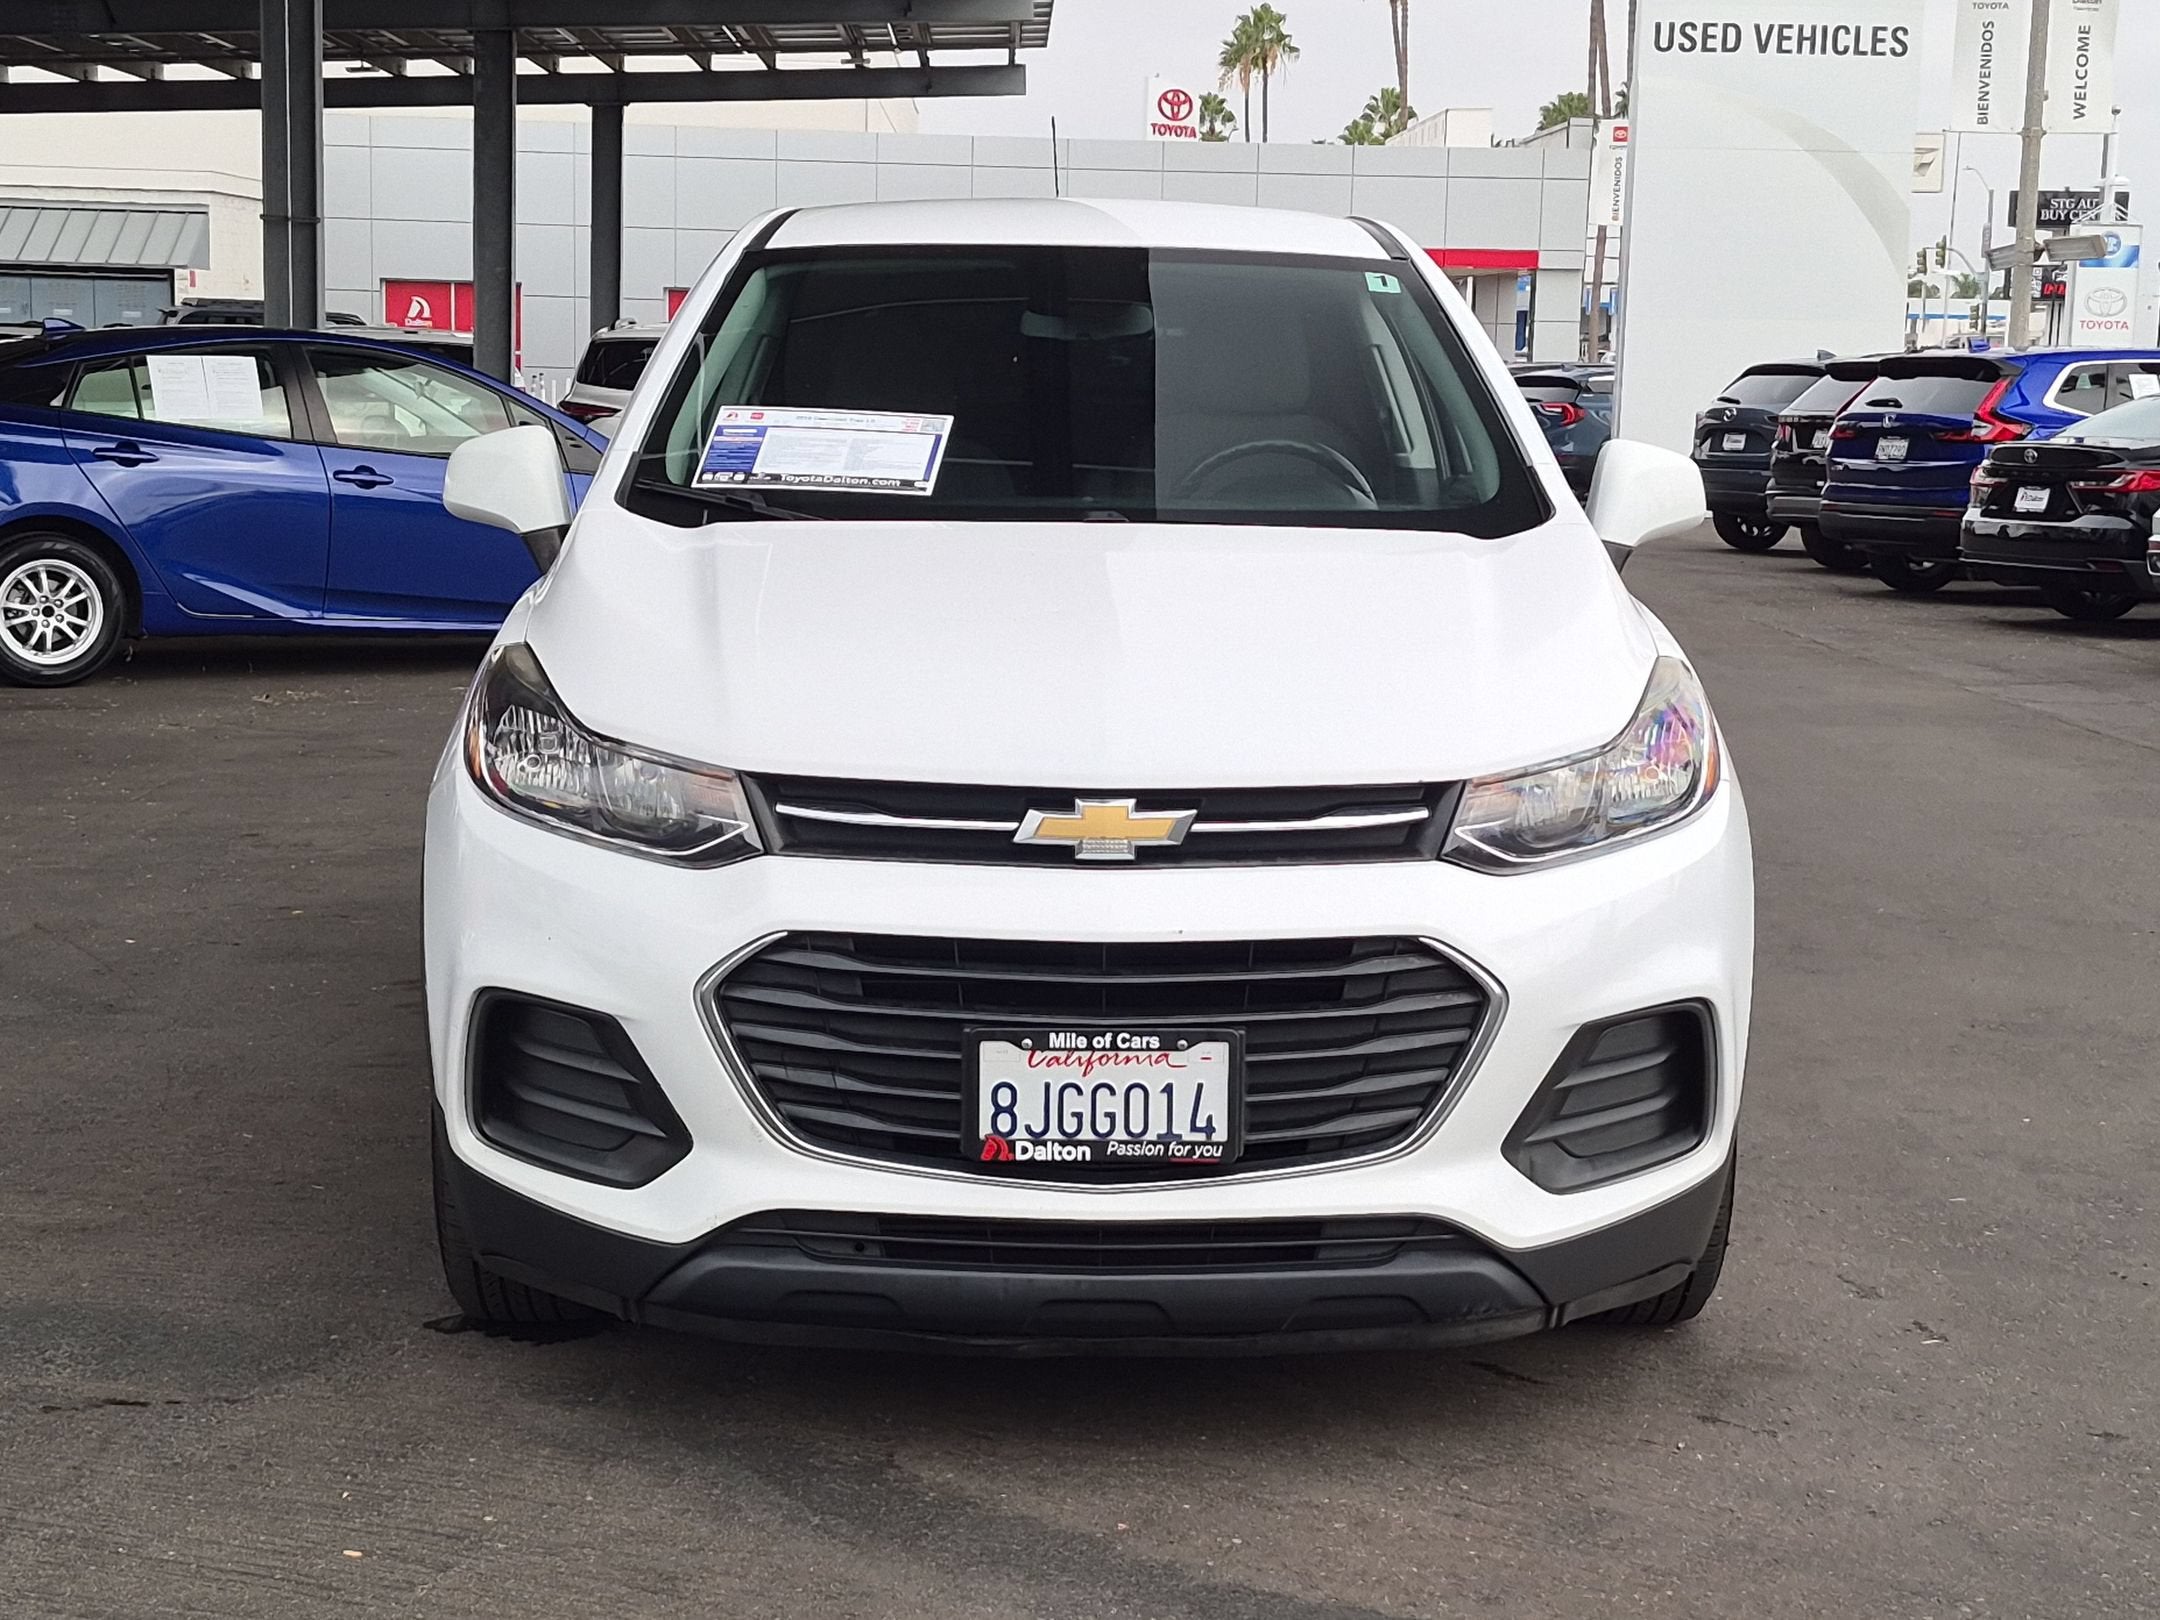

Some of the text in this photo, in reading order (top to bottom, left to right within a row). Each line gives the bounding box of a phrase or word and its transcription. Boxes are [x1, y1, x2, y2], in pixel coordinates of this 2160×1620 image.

[1972, 2, 2009, 10] TOYOTA
[1653, 21, 1909, 57] USED VEHICLES
[1977, 20, 1995, 125] BIENVENIDOS
[2073, 25, 2091, 120] WELCOME
[1151, 123, 1197, 138] TOYOTA
[1611, 156, 1623, 221] BIENVENIDOS
[2040, 209, 2068, 220] BUY
[2080, 320, 2129, 330] TOYOTA
[778, 473, 900, 487] ToyotaDalton.com
[1050, 1033, 1160, 1049] Mile of Cars
[1027, 1050, 1187, 1077] California
[990, 1081, 1217, 1140] 8JGG014
[1015, 1141, 1091, 1161] Dalton
[1107, 1140, 1222, 1159] Passion for you
